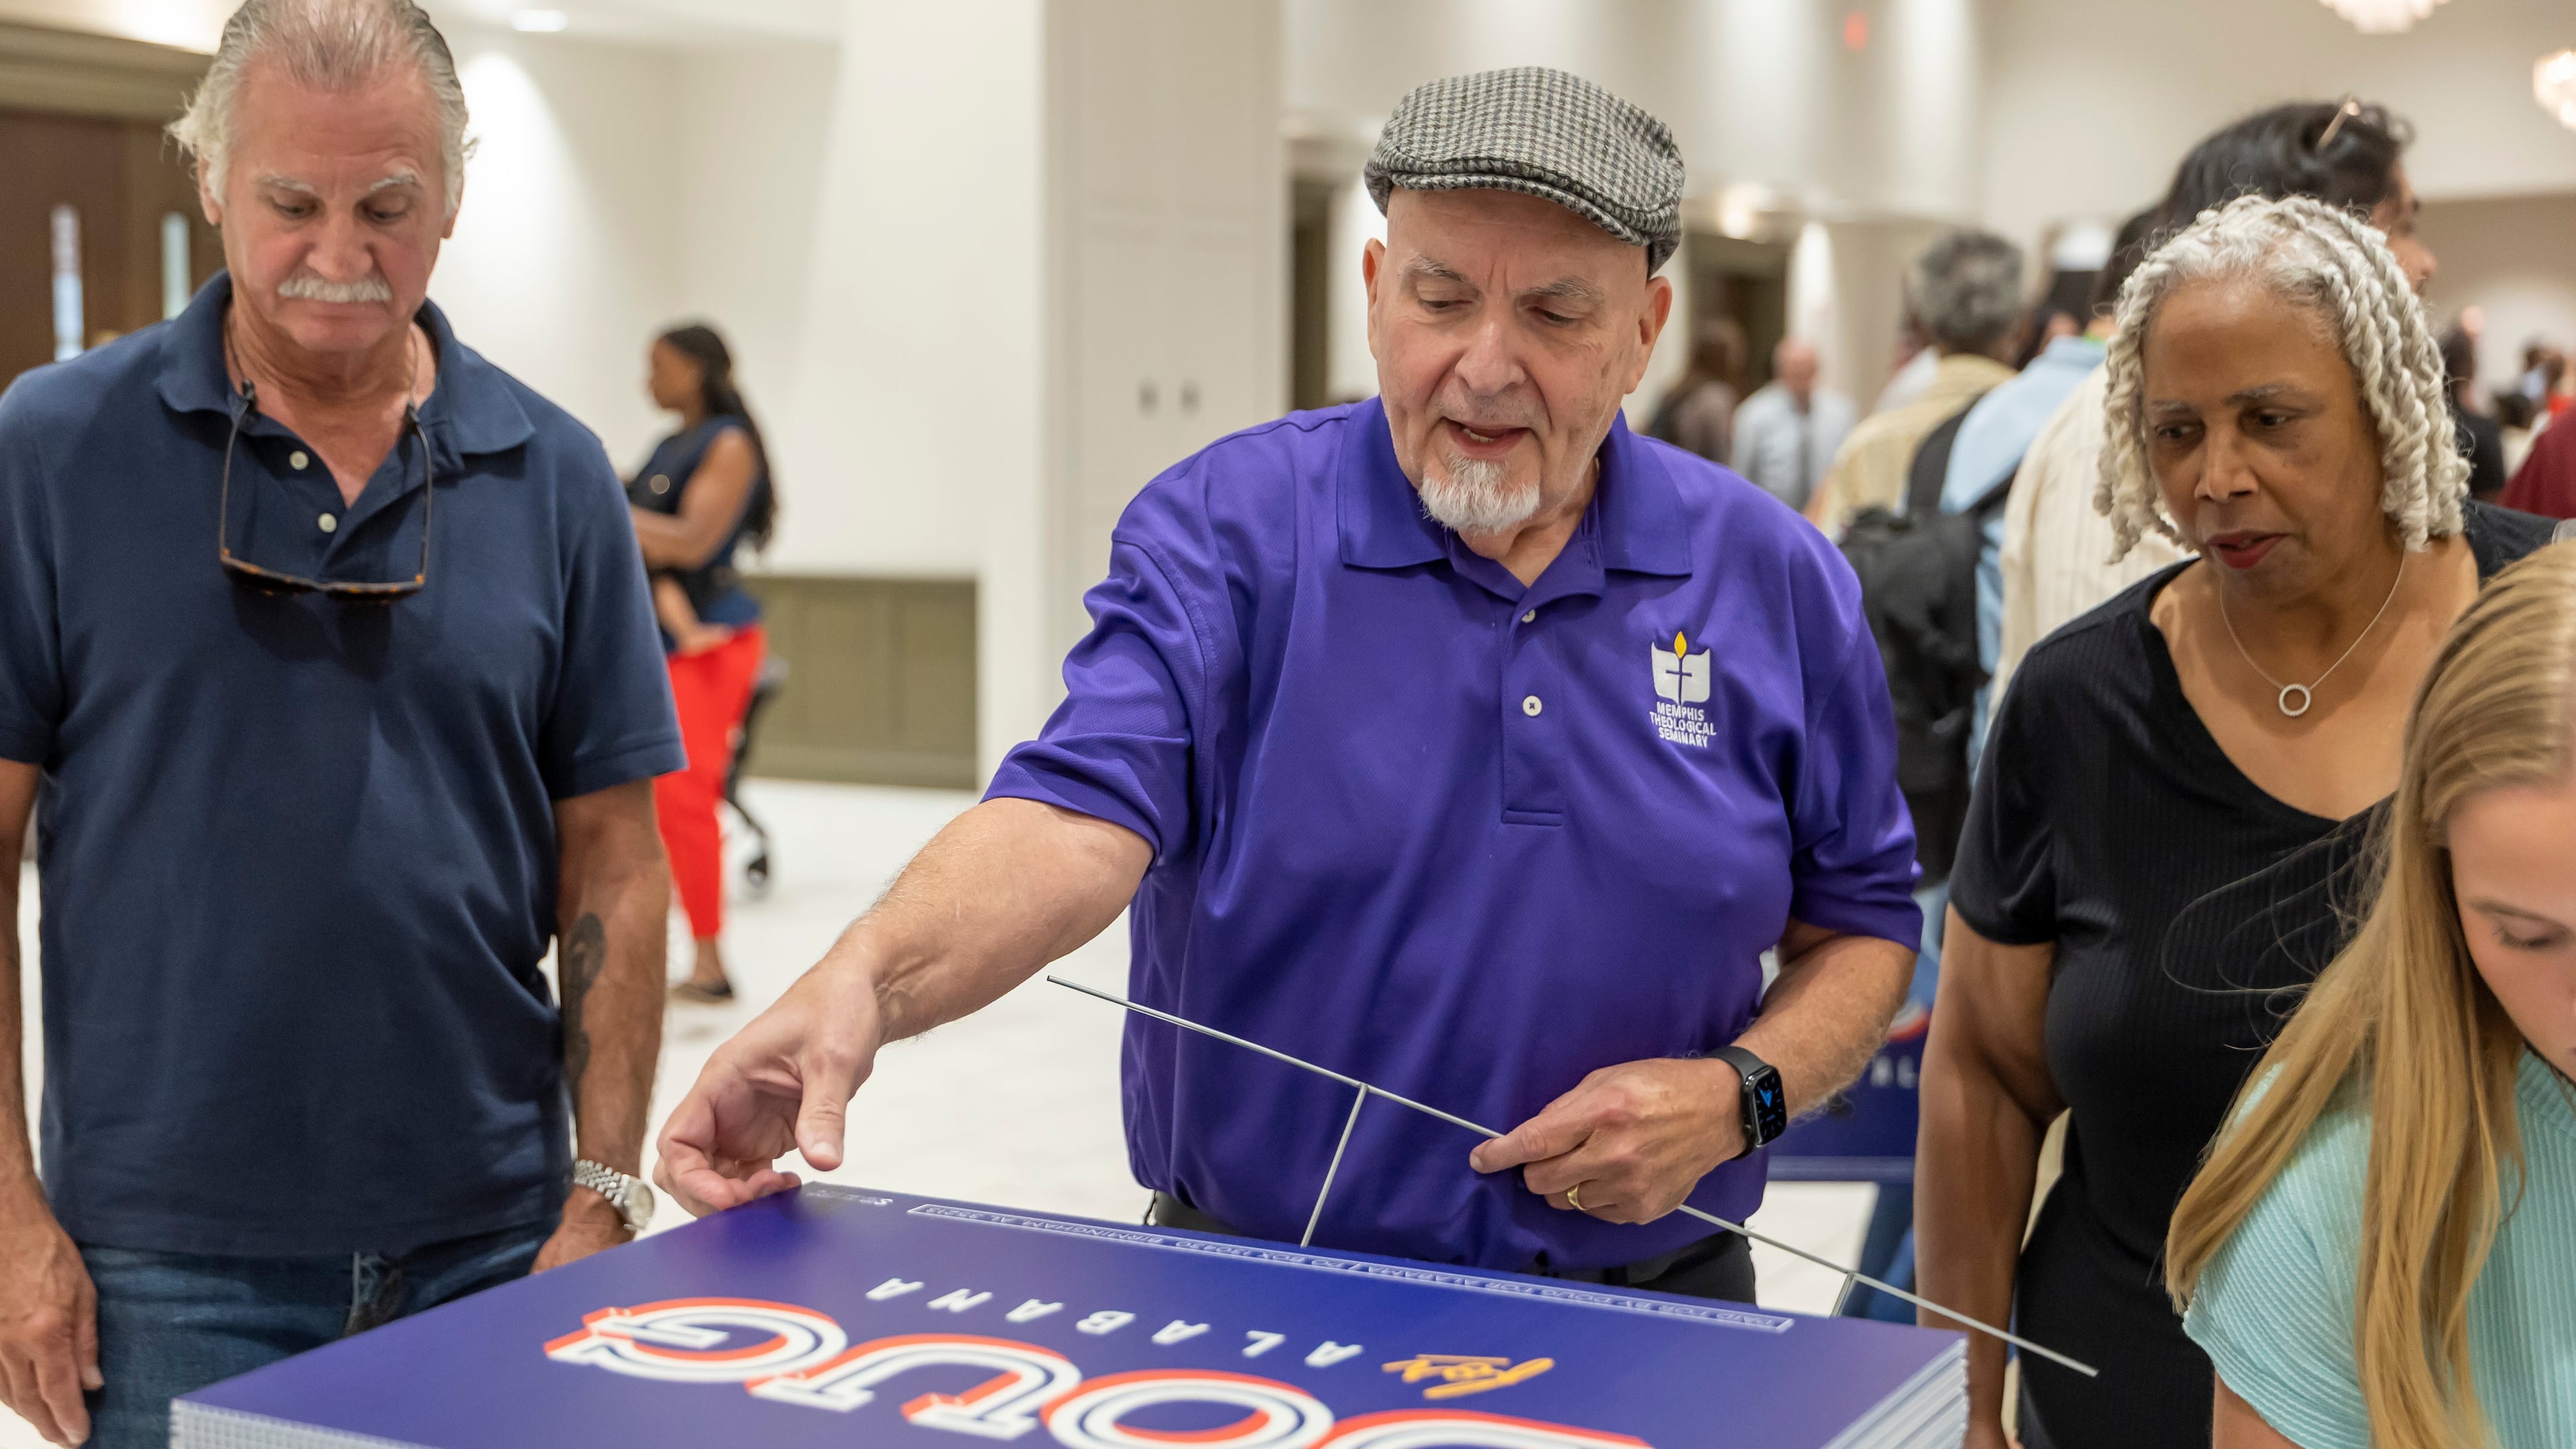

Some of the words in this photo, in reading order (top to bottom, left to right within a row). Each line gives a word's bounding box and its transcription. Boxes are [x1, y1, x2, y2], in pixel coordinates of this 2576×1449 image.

[1656, 701, 1705, 720] MEMPHIS
[1649, 712, 1717, 735] THEOLOGICAL
[1658, 727, 1708, 747] SEMINARY
[1369, 1266, 1480, 1286] ALABAMA
[1484, 1282, 1534, 1293] FOR
[1542, 1288, 1610, 1302] DOUG
[1619, 1299, 1652, 1309] BY
[1659, 1305, 1708, 1316] FOR
[865, 1278, 1364, 1368] ALABAMA
[1716, 1312, 1772, 1325] PAID
[1382, 1354, 1554, 1399] for
